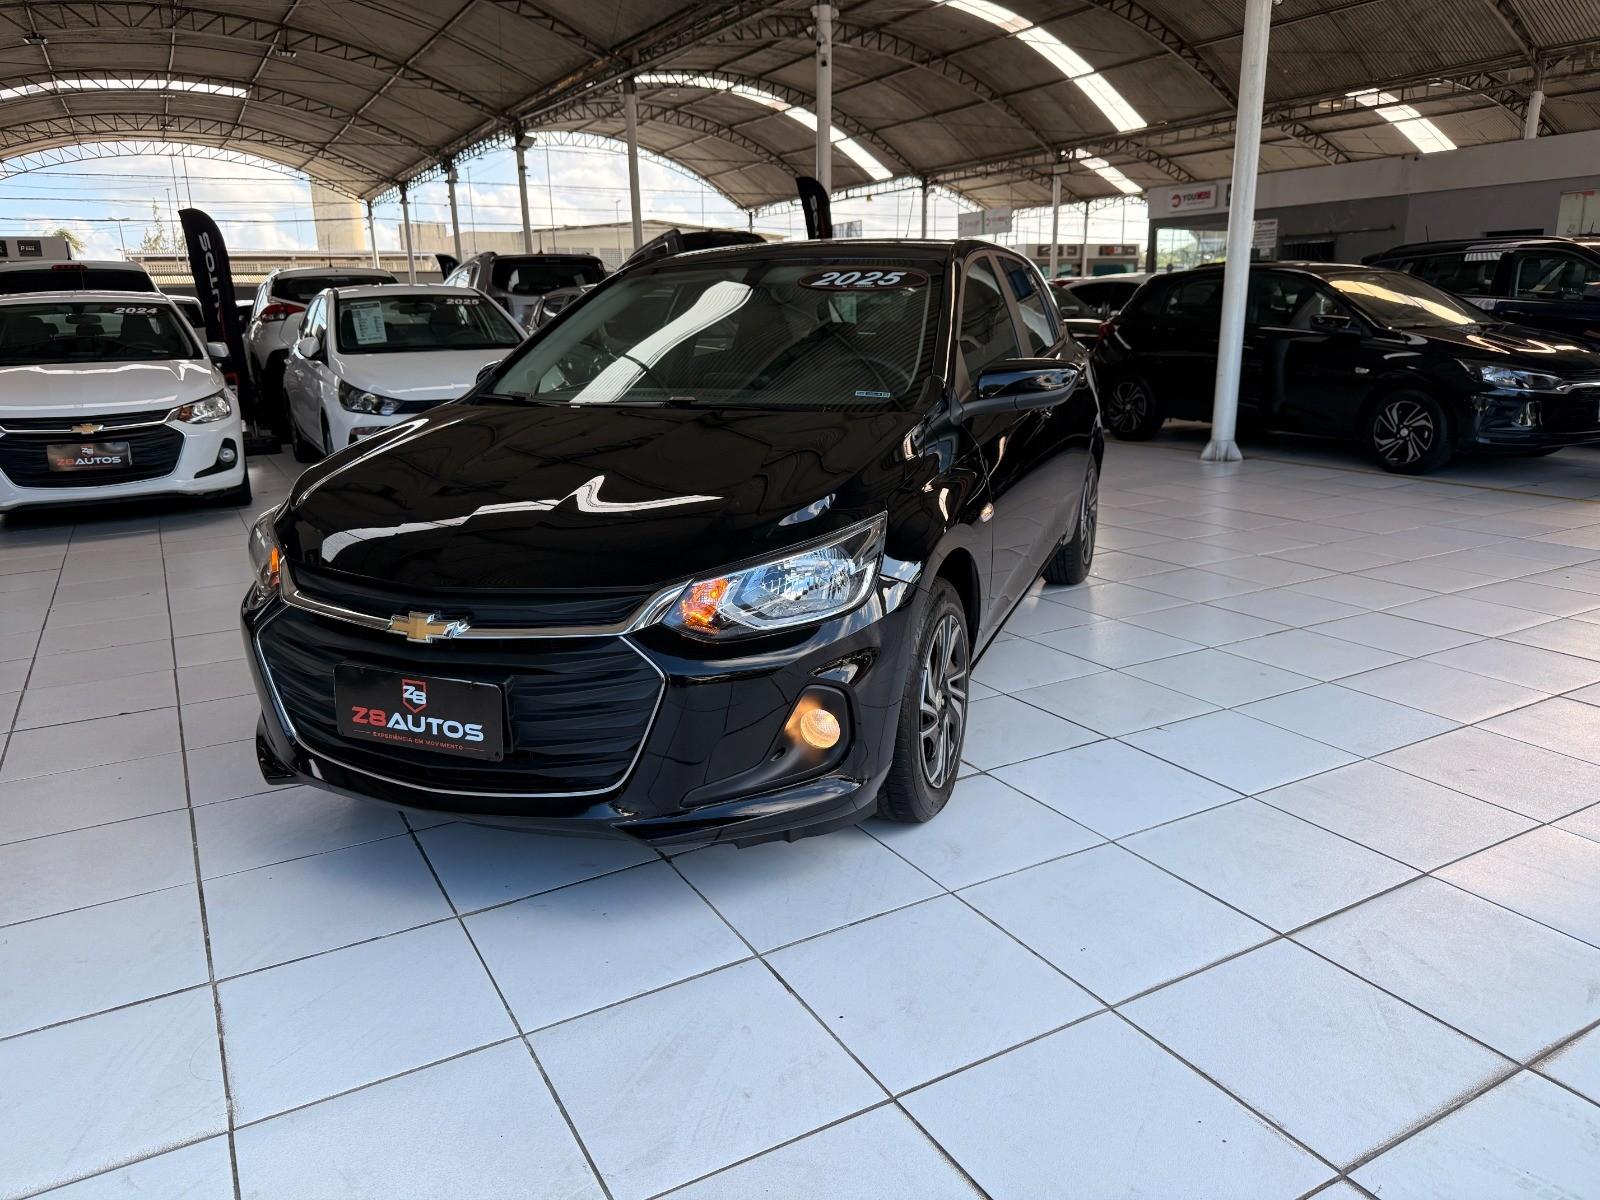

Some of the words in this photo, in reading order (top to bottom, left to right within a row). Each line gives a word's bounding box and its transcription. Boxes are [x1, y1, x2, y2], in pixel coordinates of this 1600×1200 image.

[809, 271, 907, 286] 2025
[402, 685, 427, 705] Z8
[351, 706, 485, 742] Z8AUTOS
[425, 739, 464, 751] MOVIMENTO
